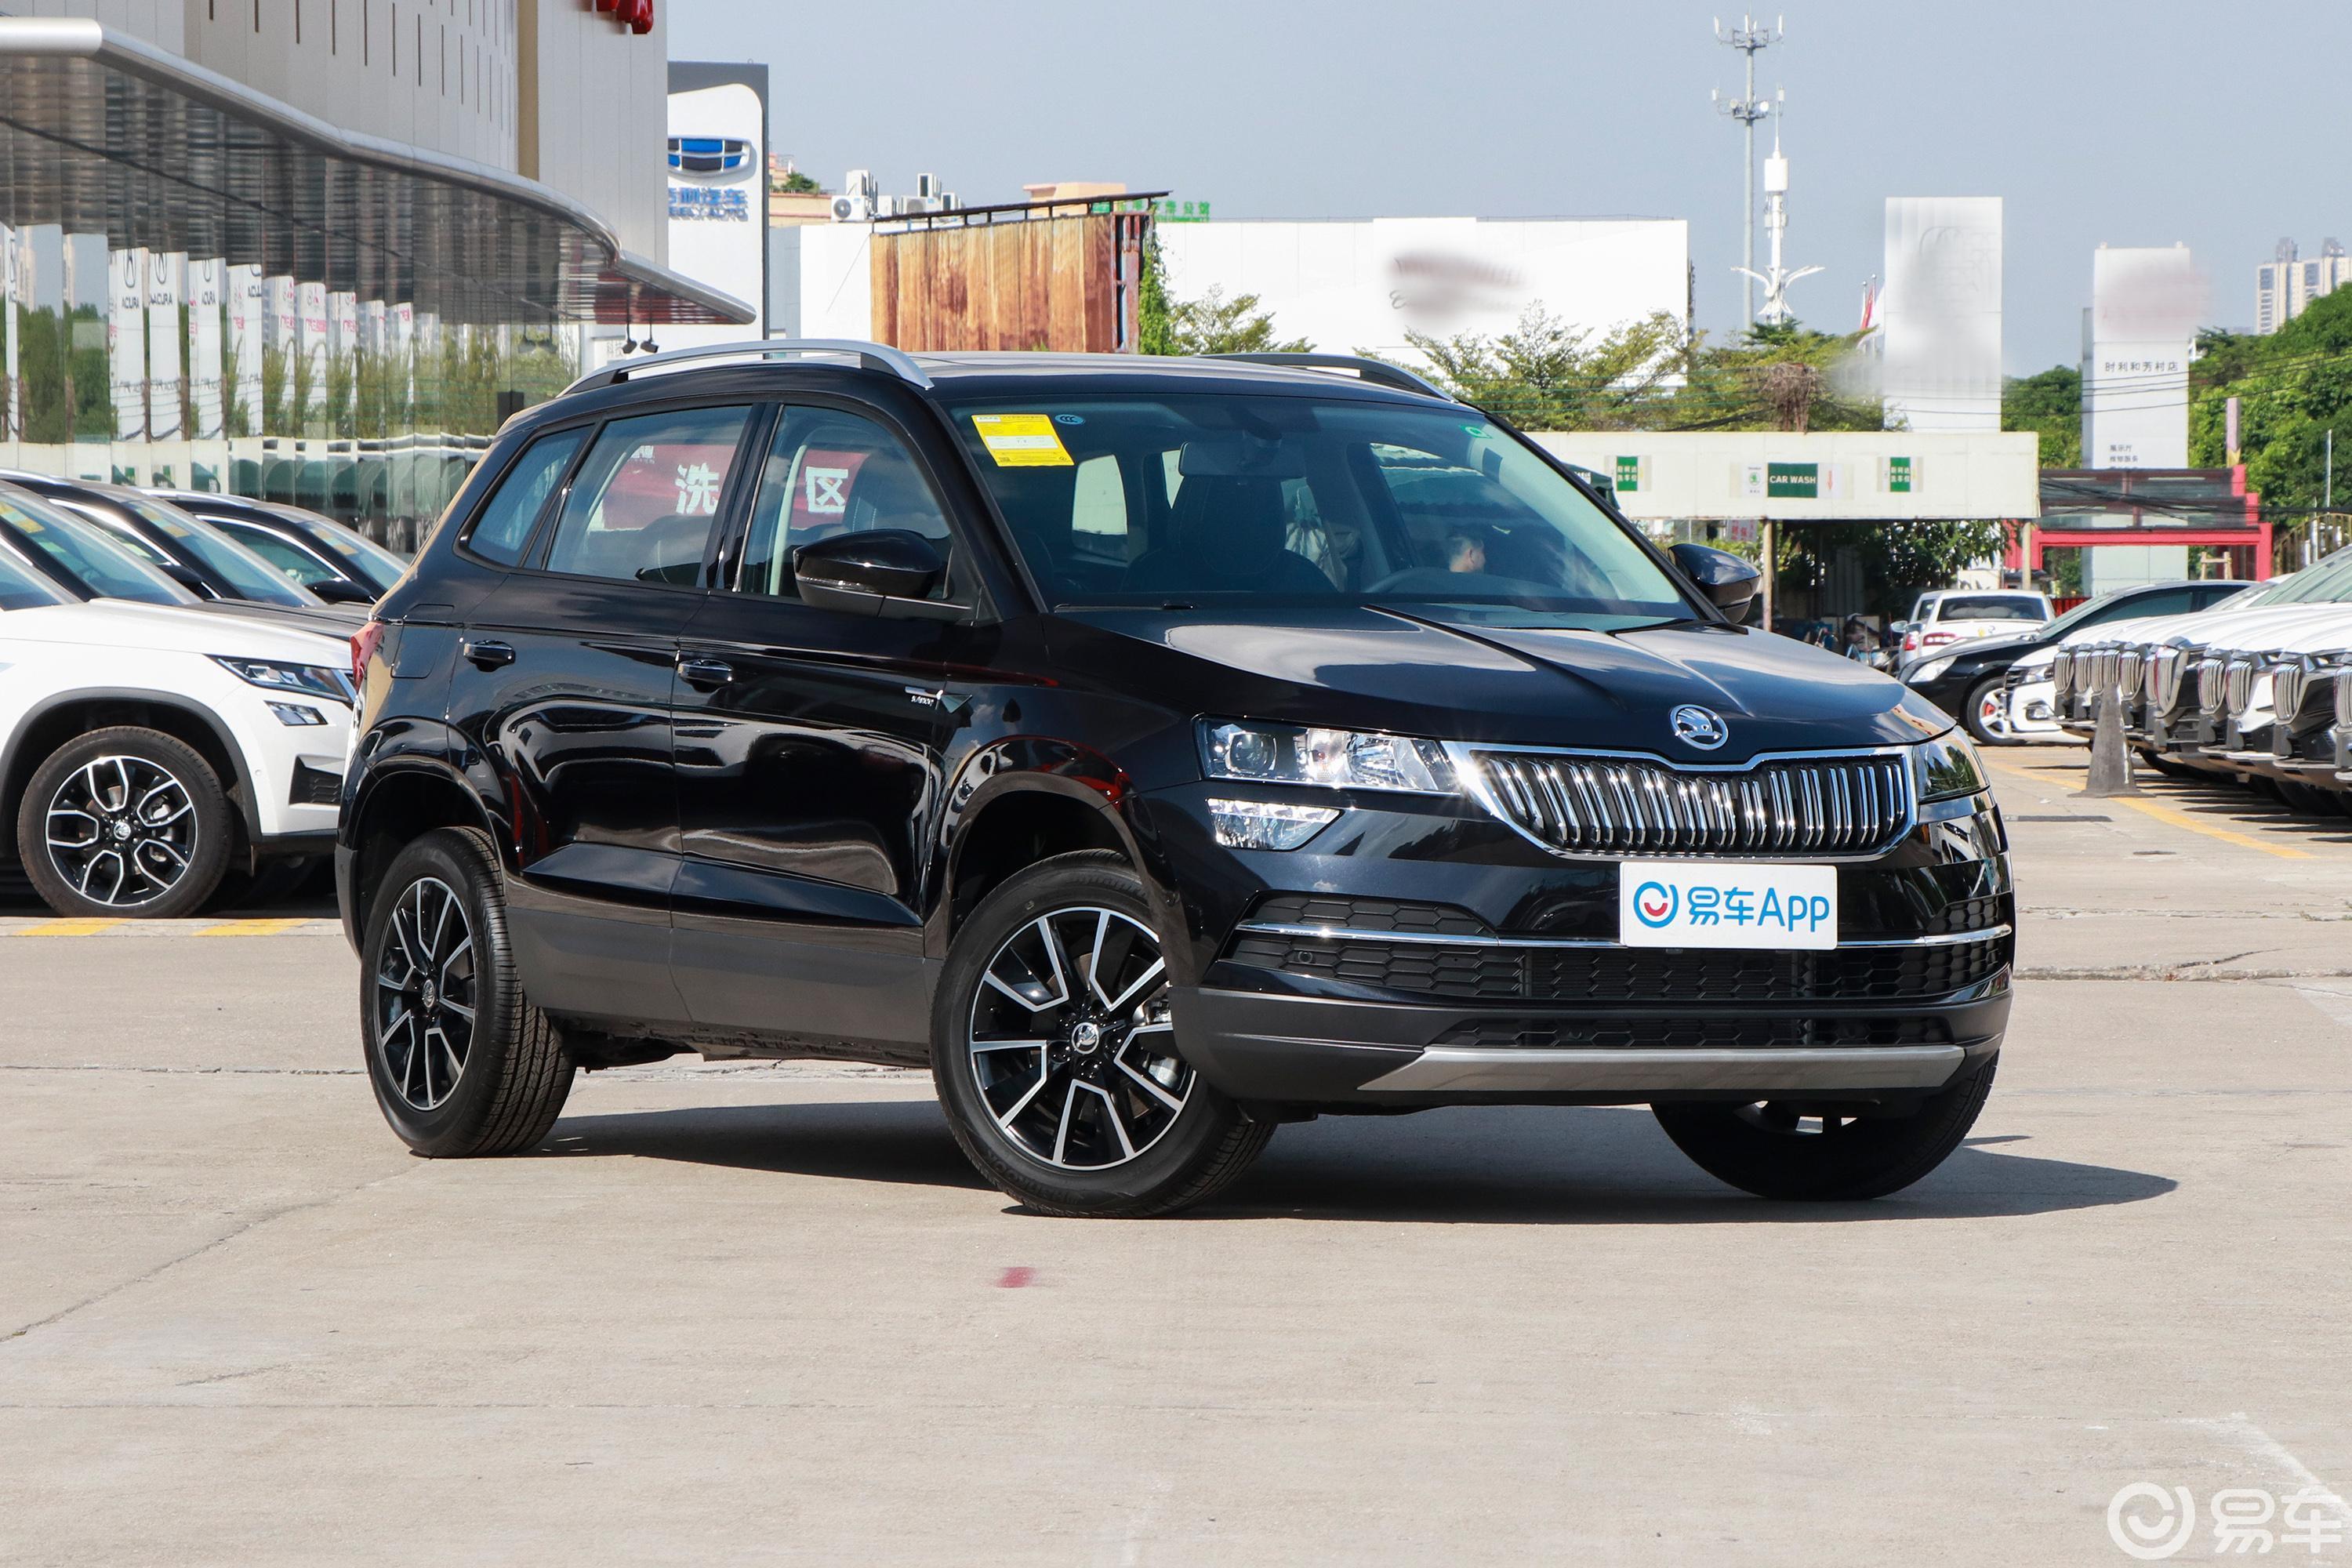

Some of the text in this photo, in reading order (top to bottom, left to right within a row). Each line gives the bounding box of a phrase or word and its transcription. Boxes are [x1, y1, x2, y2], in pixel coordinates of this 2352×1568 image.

[2105, 361, 2179, 372] 时利和芳村店
[1769, 475, 1816, 484] CAR WASH
[1687, 887, 1830, 932] 易车App
